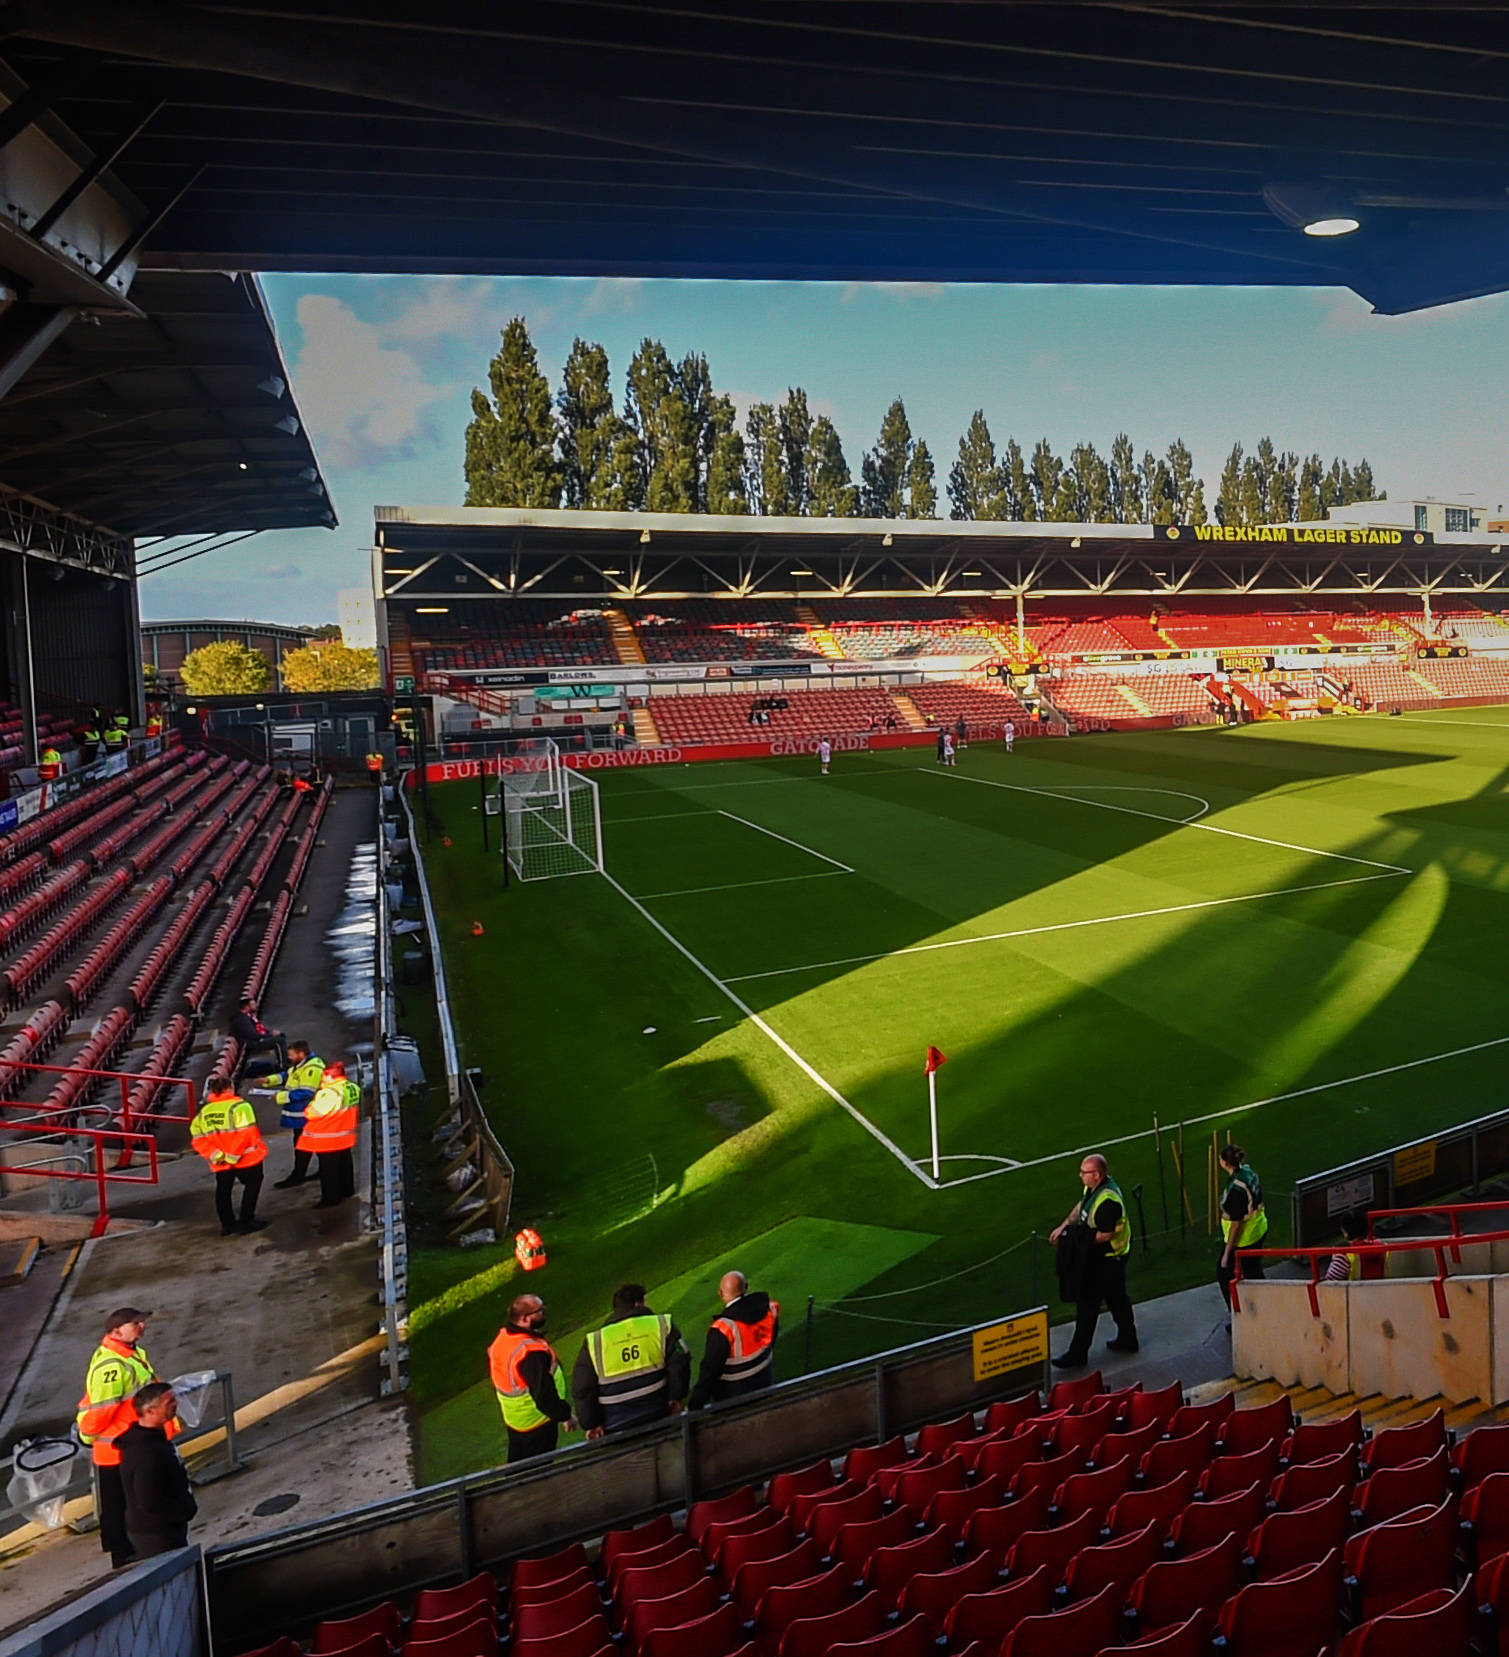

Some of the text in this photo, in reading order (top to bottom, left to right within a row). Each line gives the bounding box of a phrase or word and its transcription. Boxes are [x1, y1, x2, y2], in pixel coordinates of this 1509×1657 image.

[1194, 525, 1402, 545] WREXHAM LAGER STAND
[769, 733, 869, 755] GATOADE
[575, 749, 682, 769] FORWARD
[621, 1344, 640, 1363] 66
[103, 1369, 118, 1384] 22
